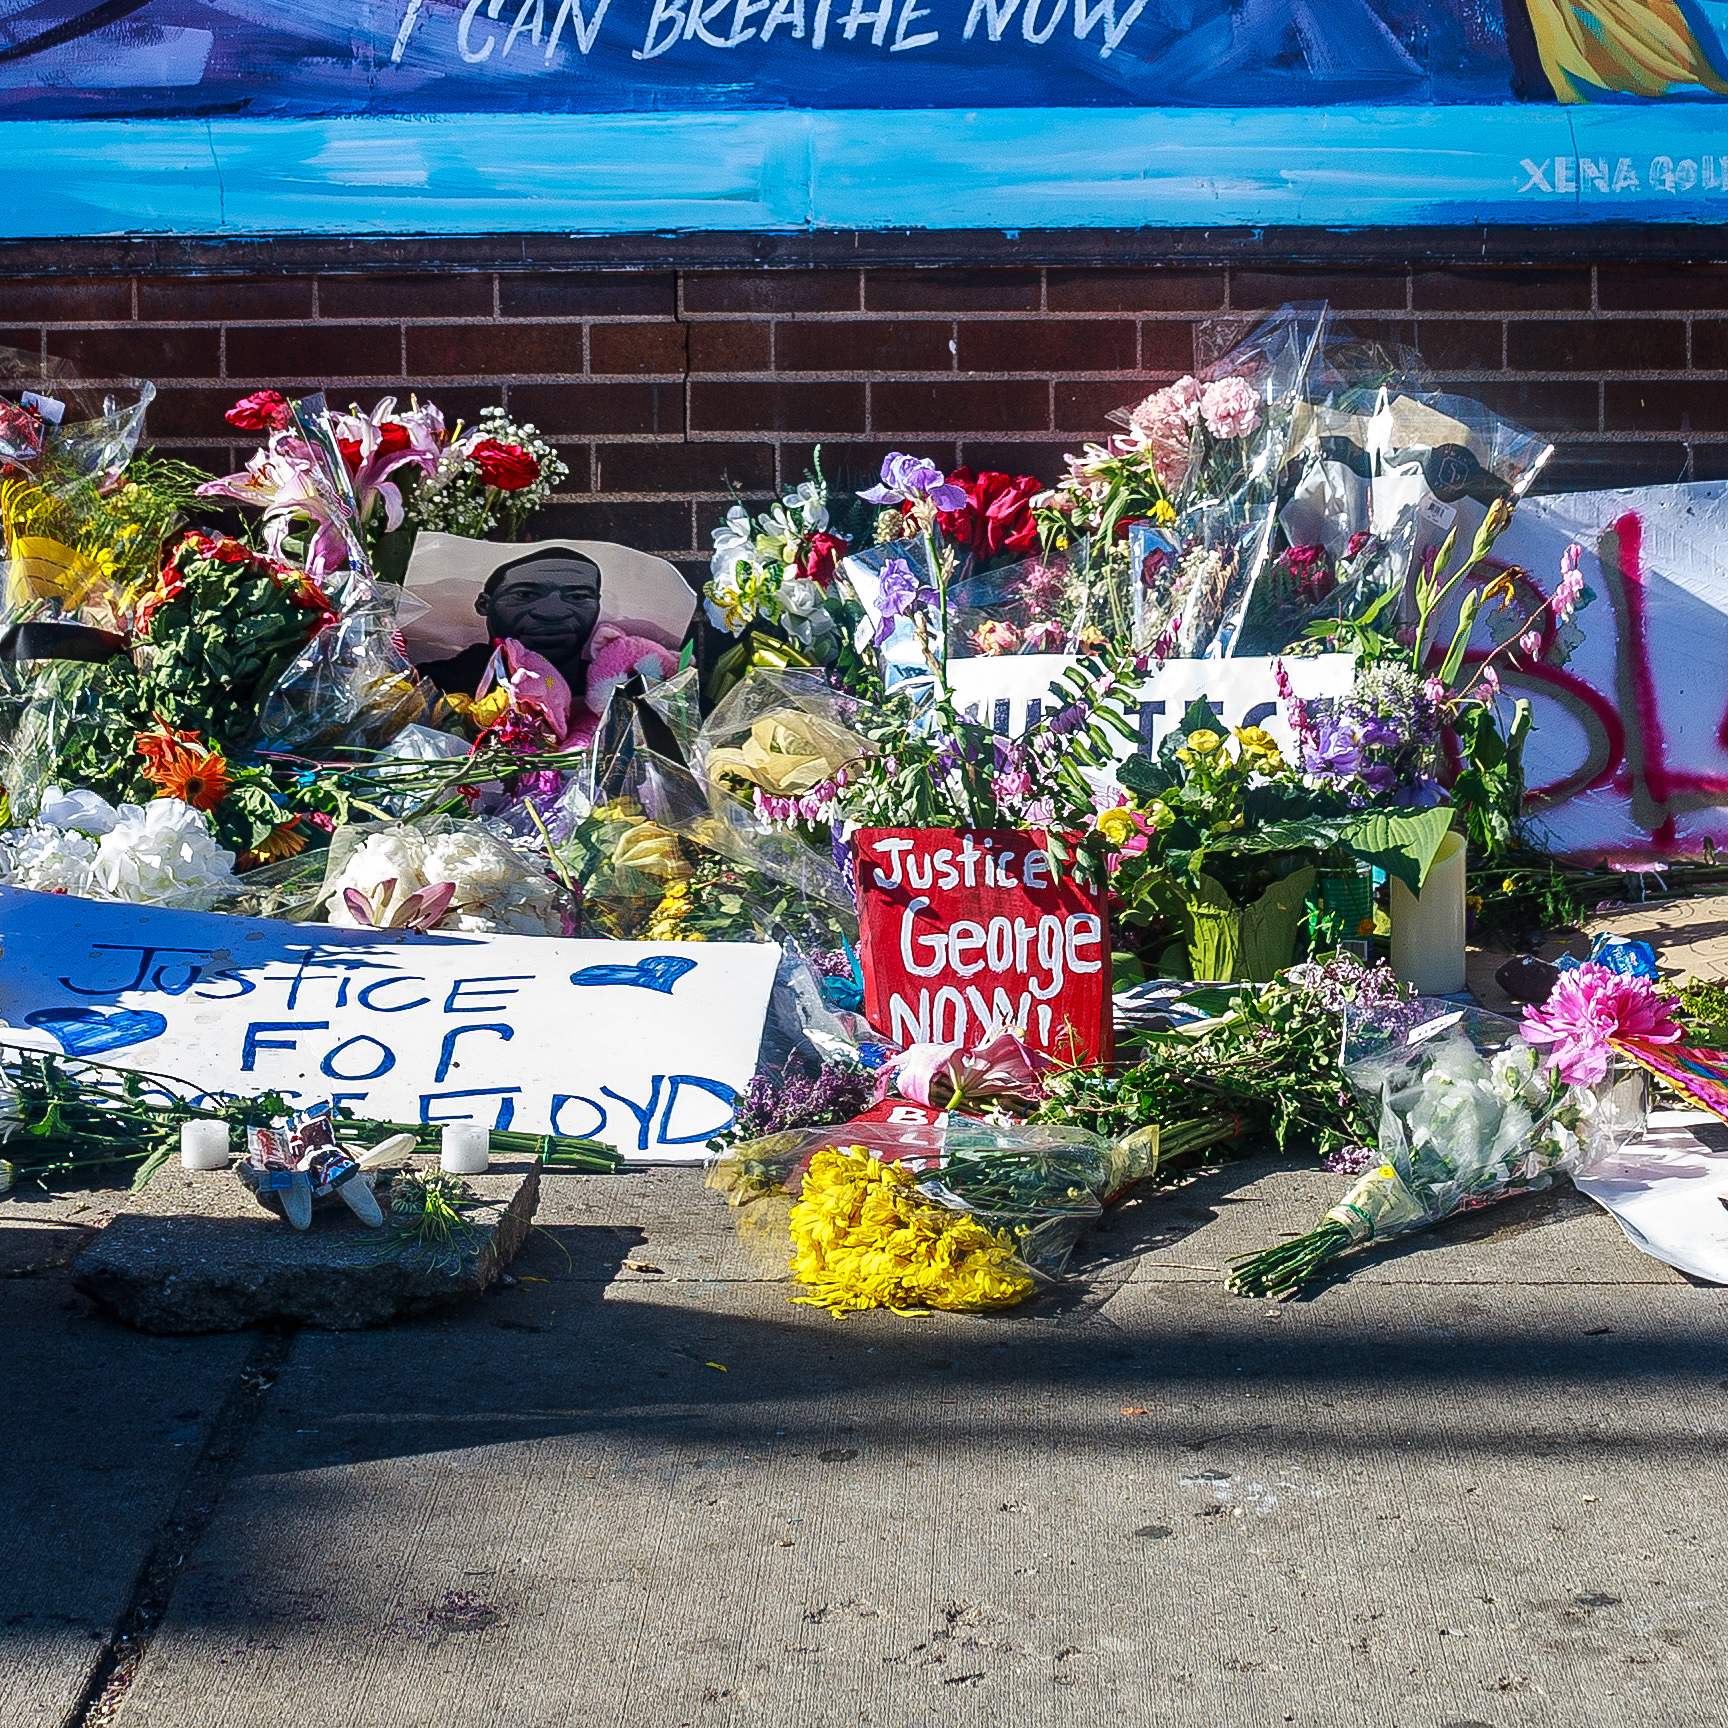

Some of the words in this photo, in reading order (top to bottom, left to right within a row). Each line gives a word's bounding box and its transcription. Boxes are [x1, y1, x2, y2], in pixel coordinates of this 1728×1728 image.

[1518, 156, 1642, 193] XENA
[872, 833, 1050, 891] Justice
[900, 896, 1103, 1001] George
